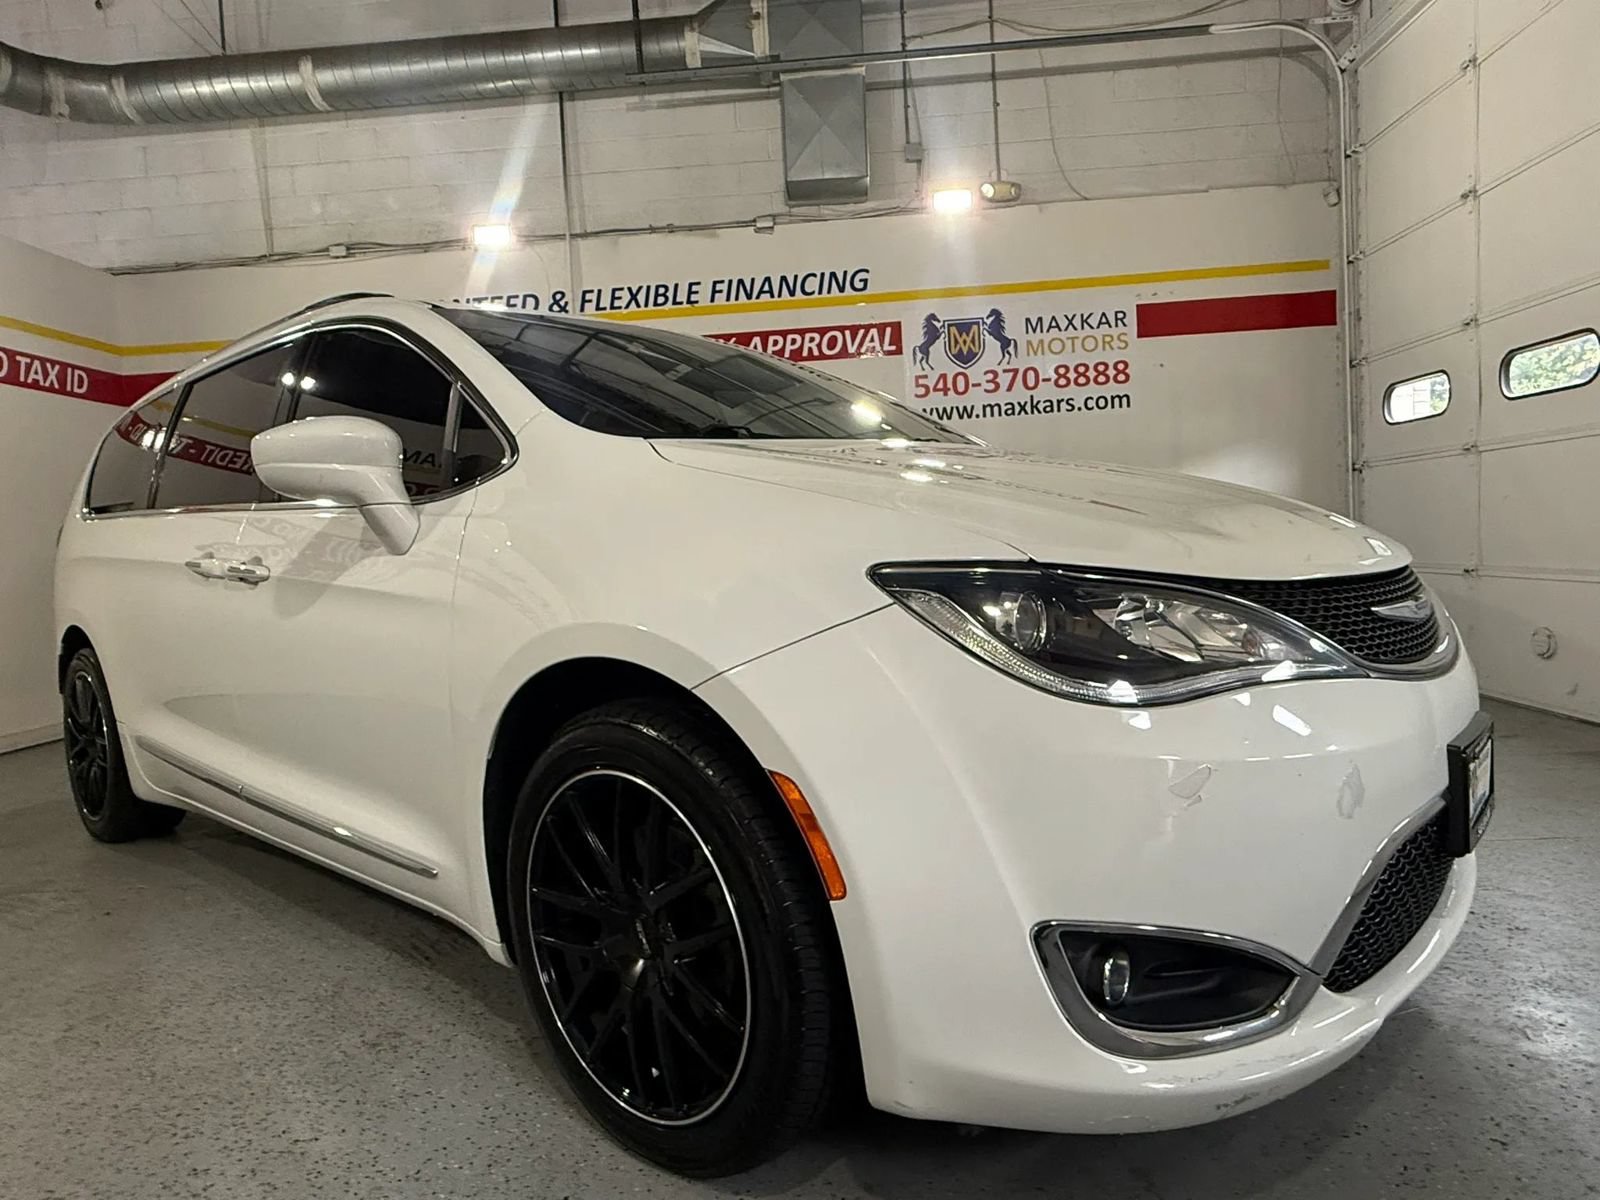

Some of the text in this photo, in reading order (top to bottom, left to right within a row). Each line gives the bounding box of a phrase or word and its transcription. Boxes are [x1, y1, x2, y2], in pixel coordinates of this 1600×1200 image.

[548, 290, 569, 314] &
[579, 281, 701, 313] FLEXIBLE
[709, 268, 870, 304] FINANCING
[1025, 310, 1128, 335] MAXKAR
[749, 326, 897, 358] APPROVAL
[1026, 332, 1129, 357] MOTORS
[16, 355, 60, 389] TAX
[66, 366, 89, 394] ID
[914, 359, 1131, 399] 540-370-8888
